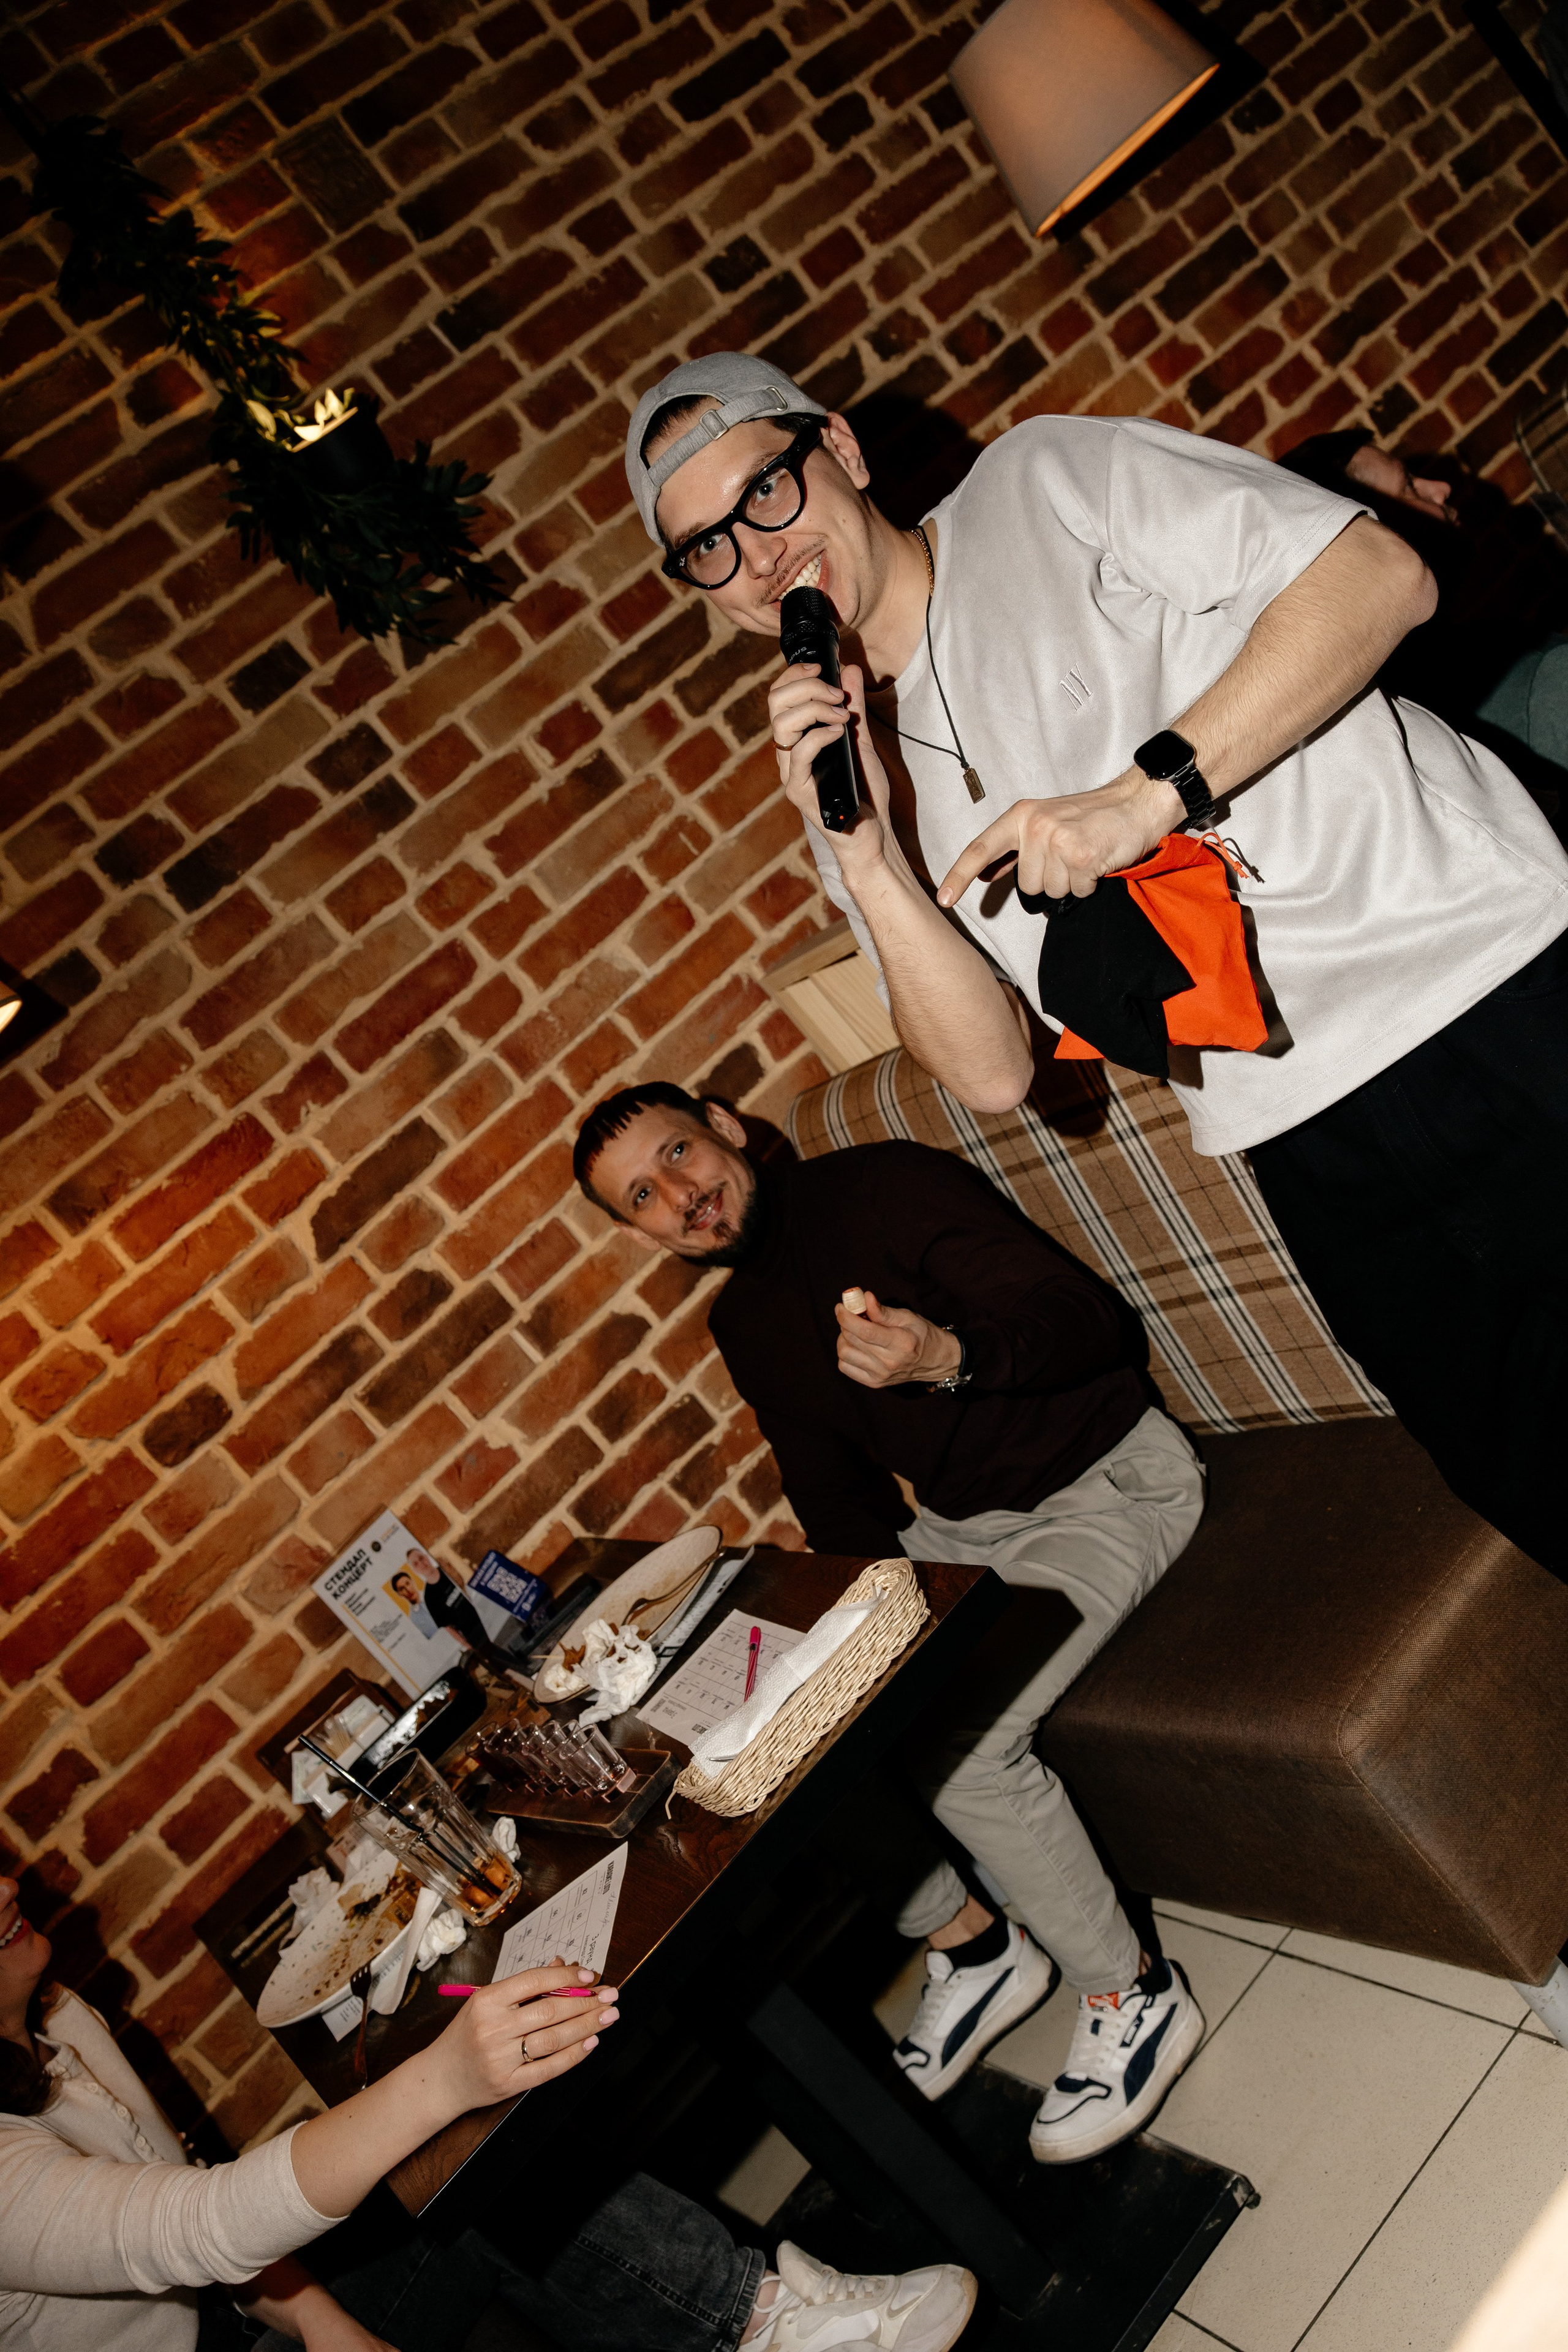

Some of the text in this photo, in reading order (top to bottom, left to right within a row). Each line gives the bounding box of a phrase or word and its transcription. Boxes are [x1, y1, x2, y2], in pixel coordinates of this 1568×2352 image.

[324, 1548, 366, 1591] СТЕНДАП
[332, 1556, 372, 1600] КОНЦЕРТ
[605, 1860, 614, 1883] KARAOKE
[602, 1880, 611, 1894] LOTO
[585, 1941, 596, 1966] раунд
